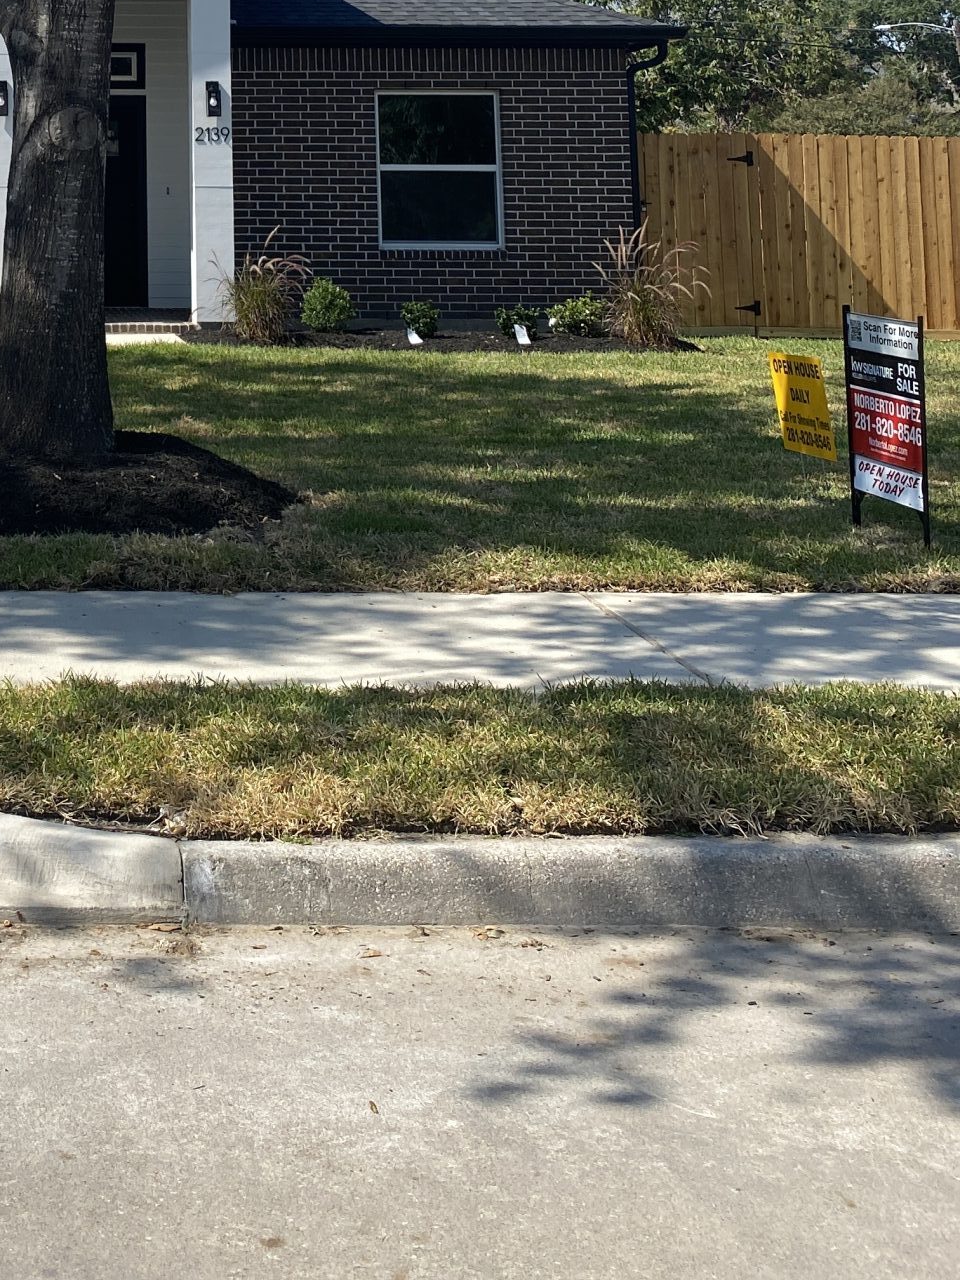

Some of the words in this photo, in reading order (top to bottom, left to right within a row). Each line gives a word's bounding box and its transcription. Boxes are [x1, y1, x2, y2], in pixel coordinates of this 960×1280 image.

[195, 127, 230, 142] 2139
[863, 321, 882, 333] Scan
[883, 324, 897, 334] For
[898, 326, 918, 339] More
[869, 334, 913, 350] Information
[773, 358, 793, 376] OPEN
[794, 361, 820, 380] HOUSE
[897, 362, 916, 379] FOR
[790, 387, 810, 404] DAILY
[896, 377, 919, 395] SALE
[854, 392, 895, 416] NORBERTO
[896, 402, 921, 423] LOPEZ
[854, 411, 922, 446] 281-820-8546
[786, 426, 832, 451] 281-820-8546
[859, 460, 885, 477] OPEN
[886, 469, 921, 489] HOUSE
[872, 478, 905, 498] TODAY
